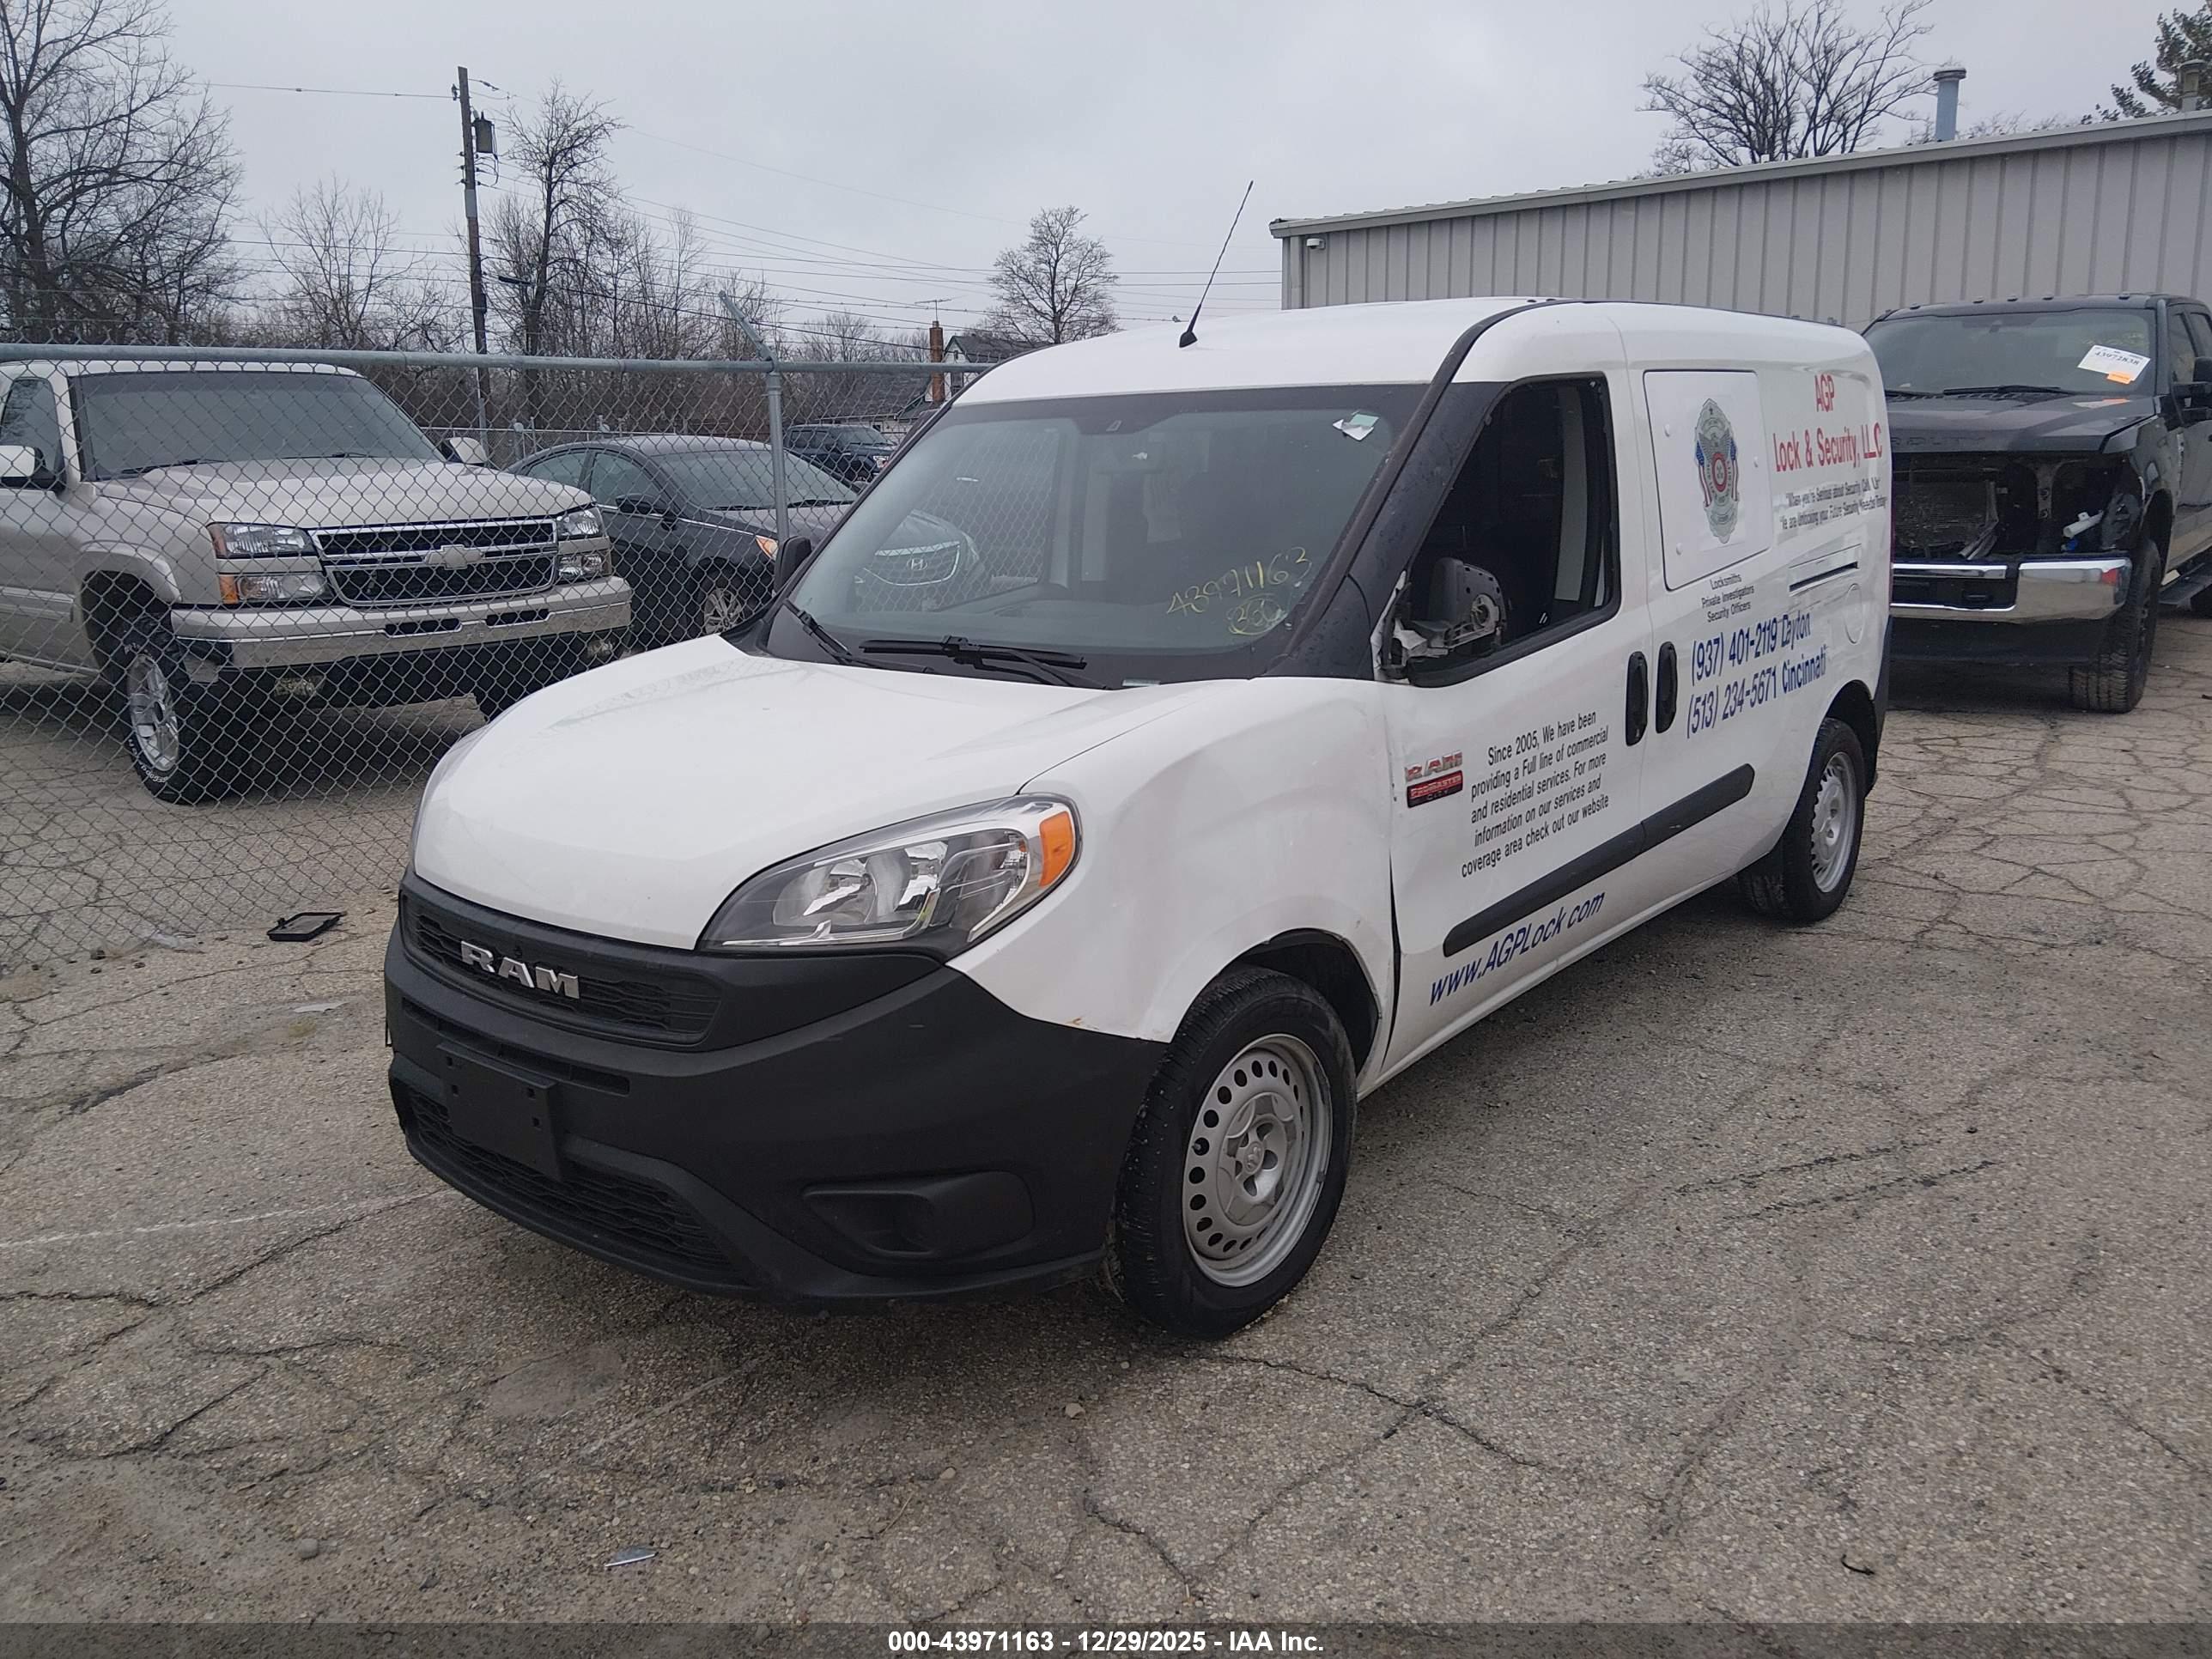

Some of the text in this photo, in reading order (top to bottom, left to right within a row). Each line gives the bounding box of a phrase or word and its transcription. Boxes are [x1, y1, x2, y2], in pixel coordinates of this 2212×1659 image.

[1814, 374, 1835, 412] AGP
[1772, 431, 1802, 472] Lock
[1805, 428, 1814, 468] &
[1861, 422, 1883, 459] LLC
[1701, 586, 1754, 609] Private Investigators
[1710, 574, 1742, 590] Locksmiths
[1707, 602, 1751, 623] Security Officers
[1692, 611, 1811, 686] (937) 401-2119 Dayton
[1686, 644, 1827, 738] (513) 234-5671 Cincinnati
[1404, 750, 1463, 783] RAM
[1471, 726, 1609, 803] providing a Full line of commercial
[1488, 744, 1512, 766] Since
[1542, 726, 1554, 744] We
[1557, 719, 1575, 738] have
[1577, 711, 1596, 729] been
[1471, 752, 1607, 824] and residential services. For more
[1474, 773, 1601, 848] information on our services and
[1462, 794, 1609, 878] coverage area check out our website
[460, 940, 580, 999] RAM
